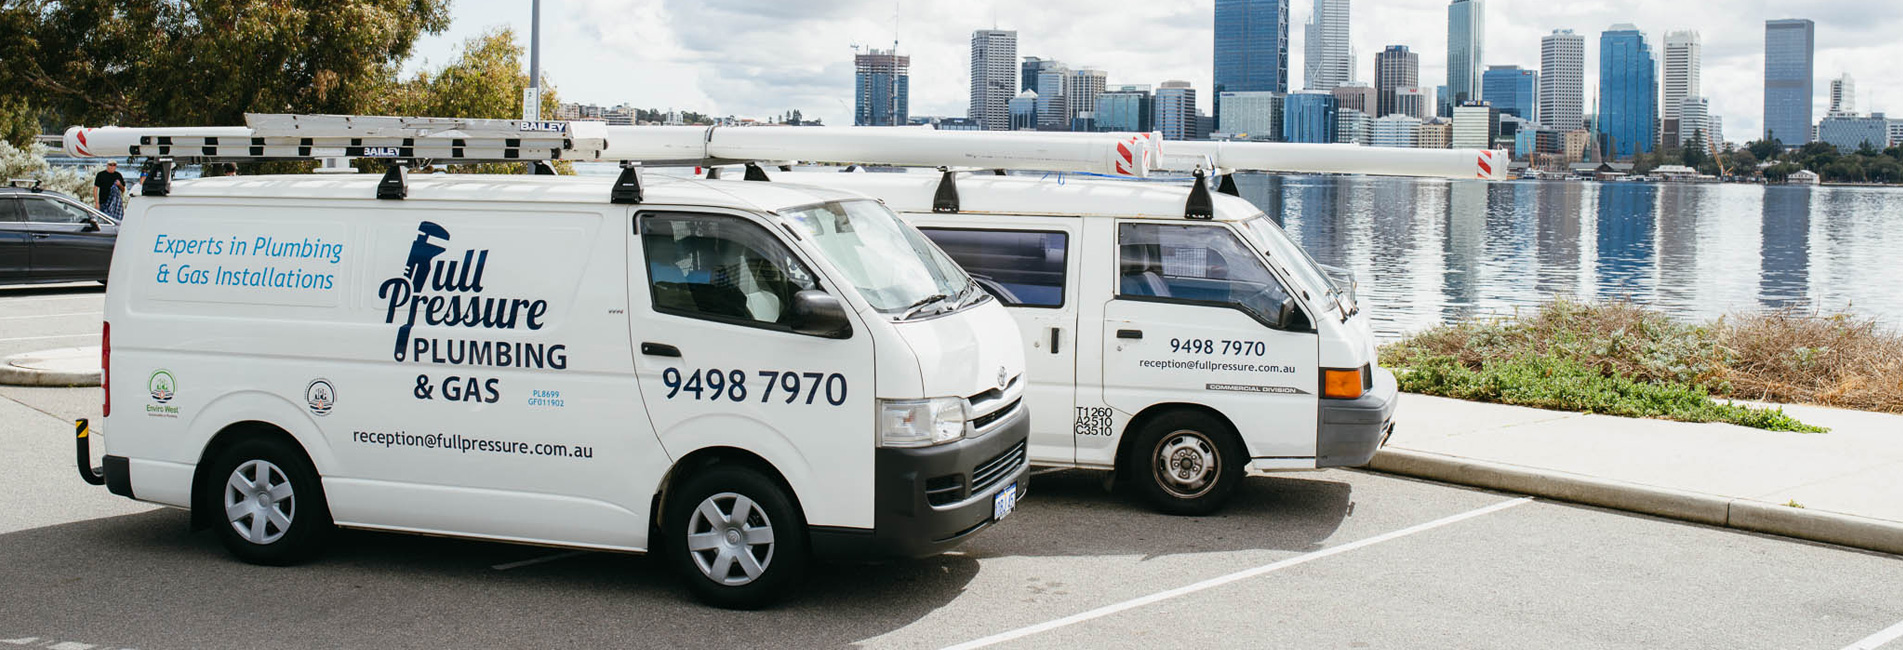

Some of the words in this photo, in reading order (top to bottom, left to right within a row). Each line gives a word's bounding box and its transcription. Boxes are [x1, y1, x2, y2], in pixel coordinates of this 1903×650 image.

[520, 121, 566, 132] BAILEY
[363, 147, 400, 156] BAILEY
[153, 234, 223, 259] Experts
[229, 236, 247, 256] in
[252, 236, 343, 264] Plumbing
[156, 264, 170, 283] &
[177, 264, 209, 285] Gas
[215, 266, 334, 290] Installations
[378, 277, 548, 331] Pressure
[413, 337, 567, 370] PLUMBING
[1170, 338, 1213, 354] 9498
[1221, 340, 1266, 357] 7970
[1139, 359, 1296, 373] reception@fullpressure.com.au
[413, 374, 434, 400] &
[441, 376, 500, 403] GAS
[533, 389, 560, 398] PL8699
[662, 367, 748, 402] 9498
[758, 370, 848, 406] 7970
[1209, 384, 1260, 392] COMMERCIAL
[1076, 406, 1113, 417] T1260
[1076, 416, 1113, 426] A2510
[1076, 425, 1113, 436] C3510
[353, 431, 594, 458] reception@fullpressure.com.au
